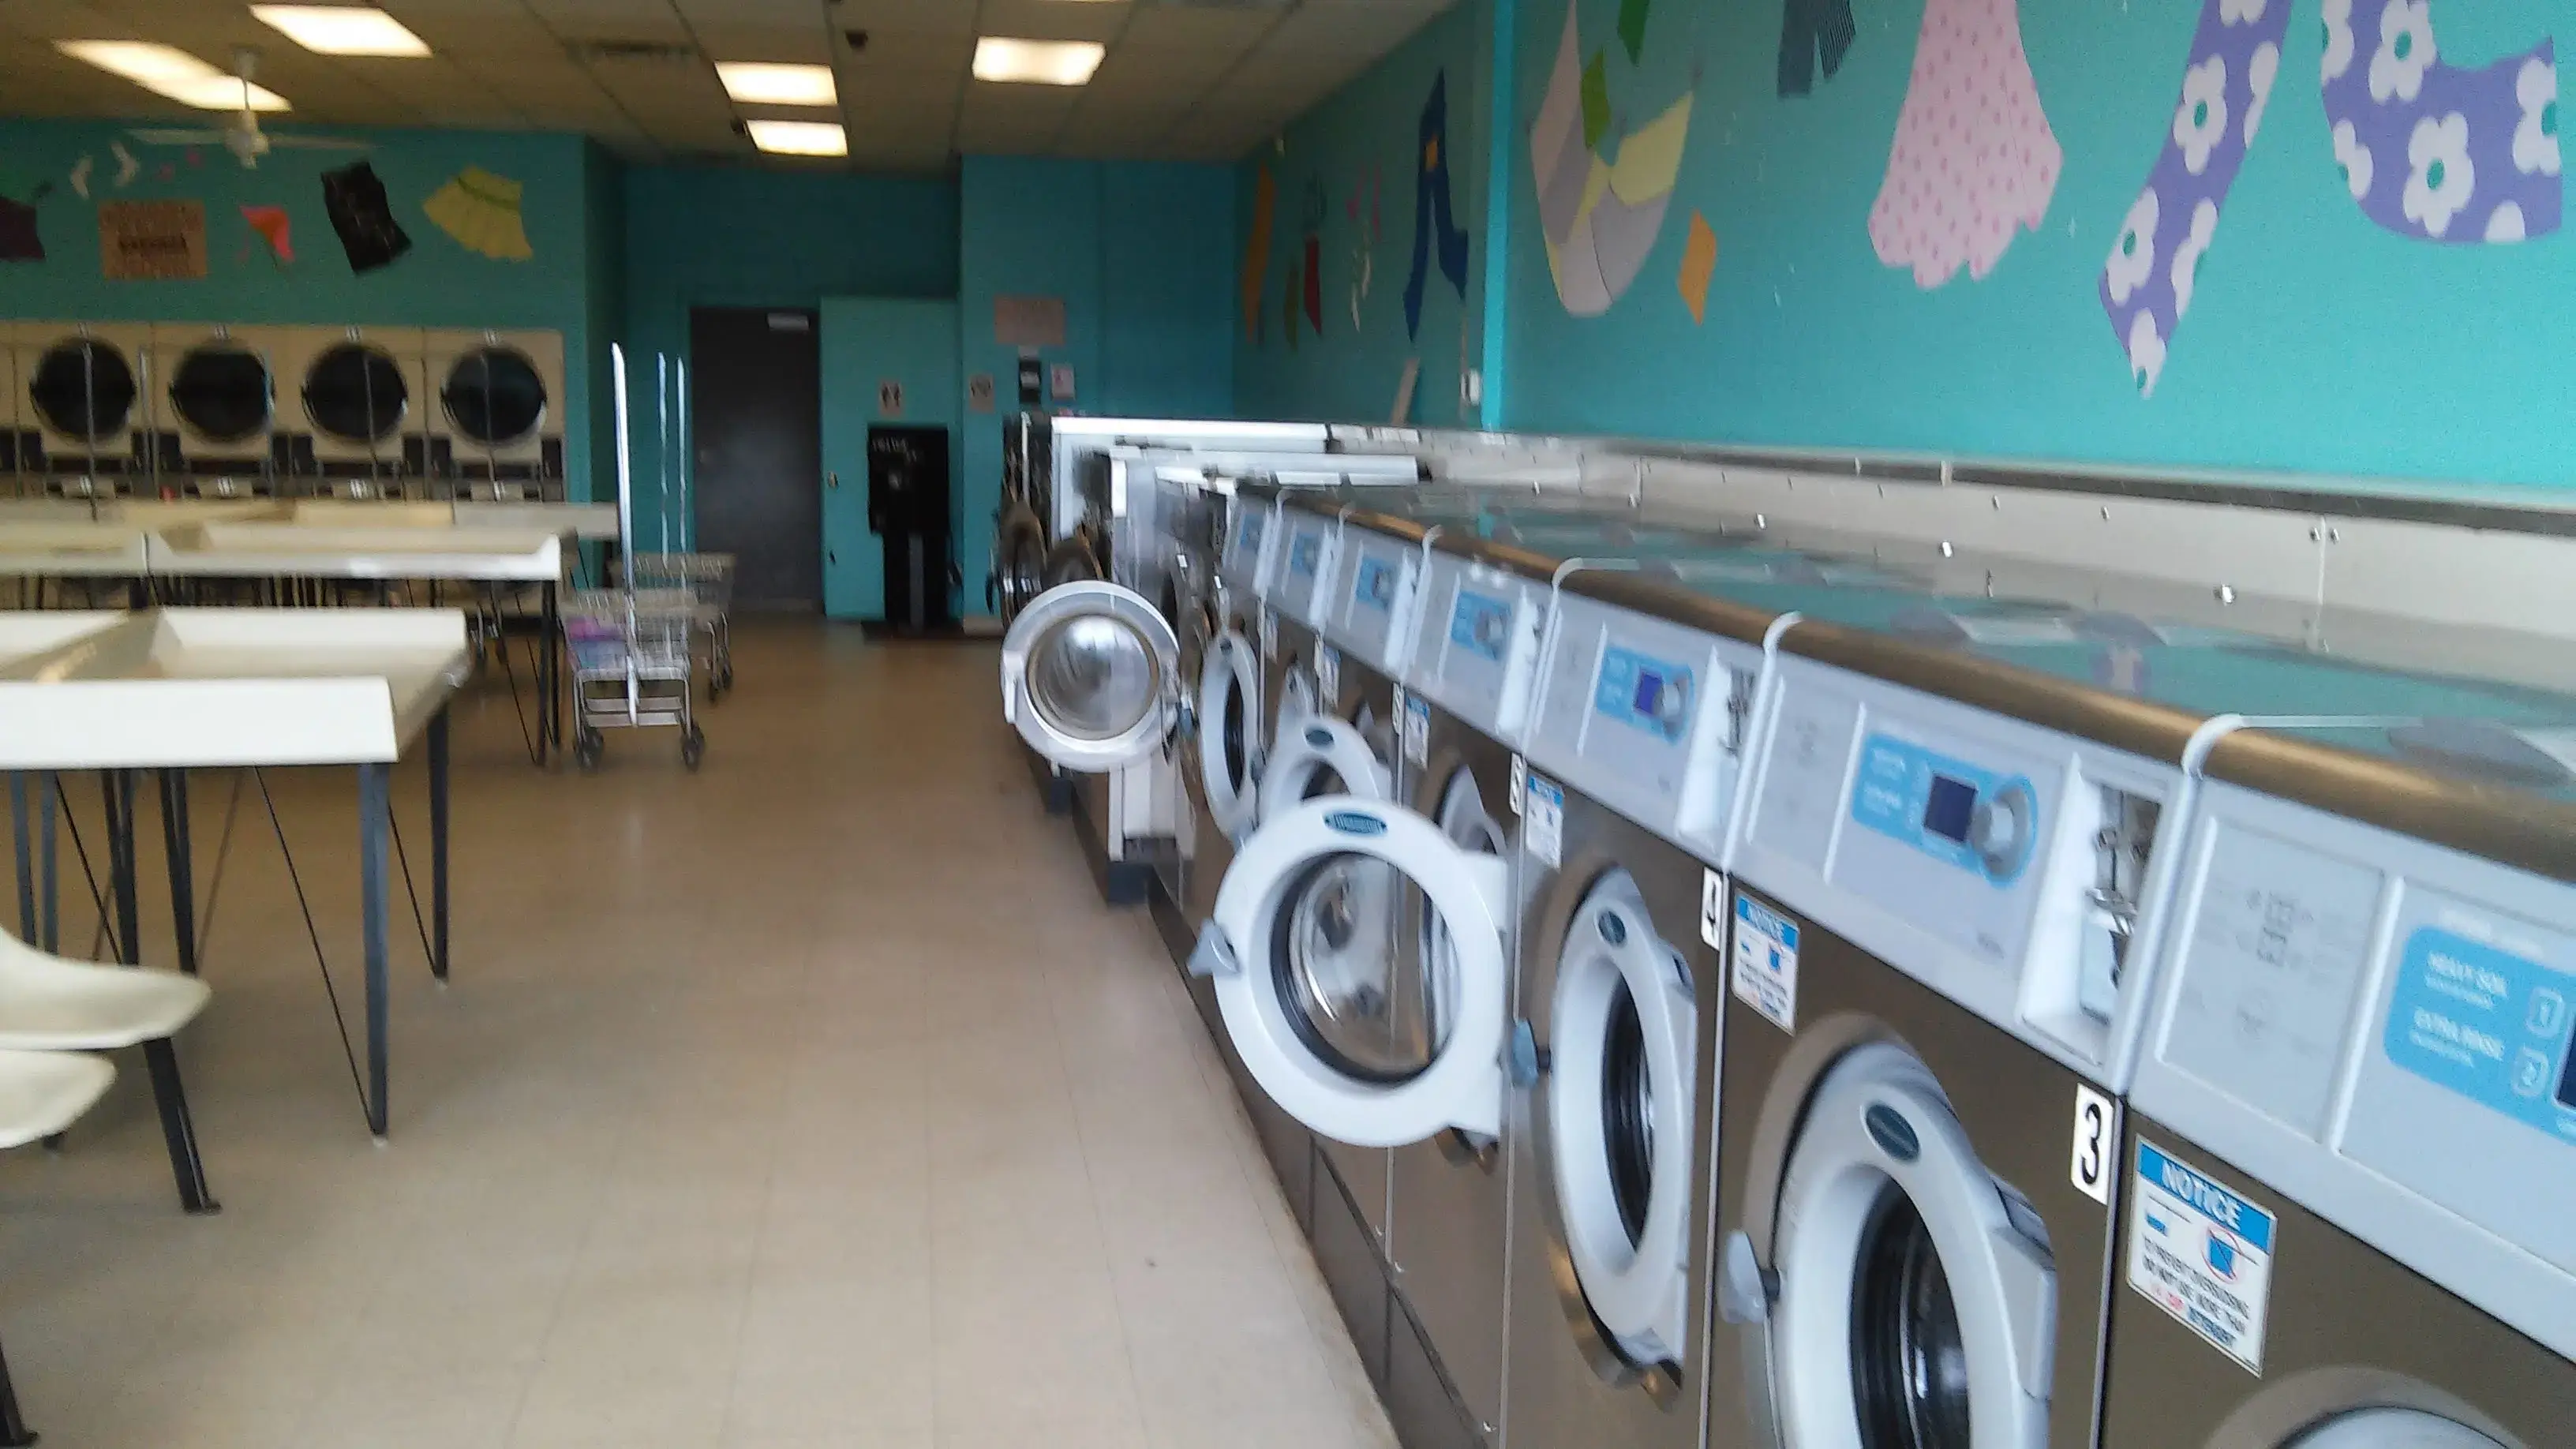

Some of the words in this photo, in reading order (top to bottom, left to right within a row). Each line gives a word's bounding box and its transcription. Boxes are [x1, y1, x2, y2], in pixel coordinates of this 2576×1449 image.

[1705, 880, 1717, 940] 4
[2081, 1103, 2102, 1185] 3
[2161, 1157, 2243, 1233] NOTICE
